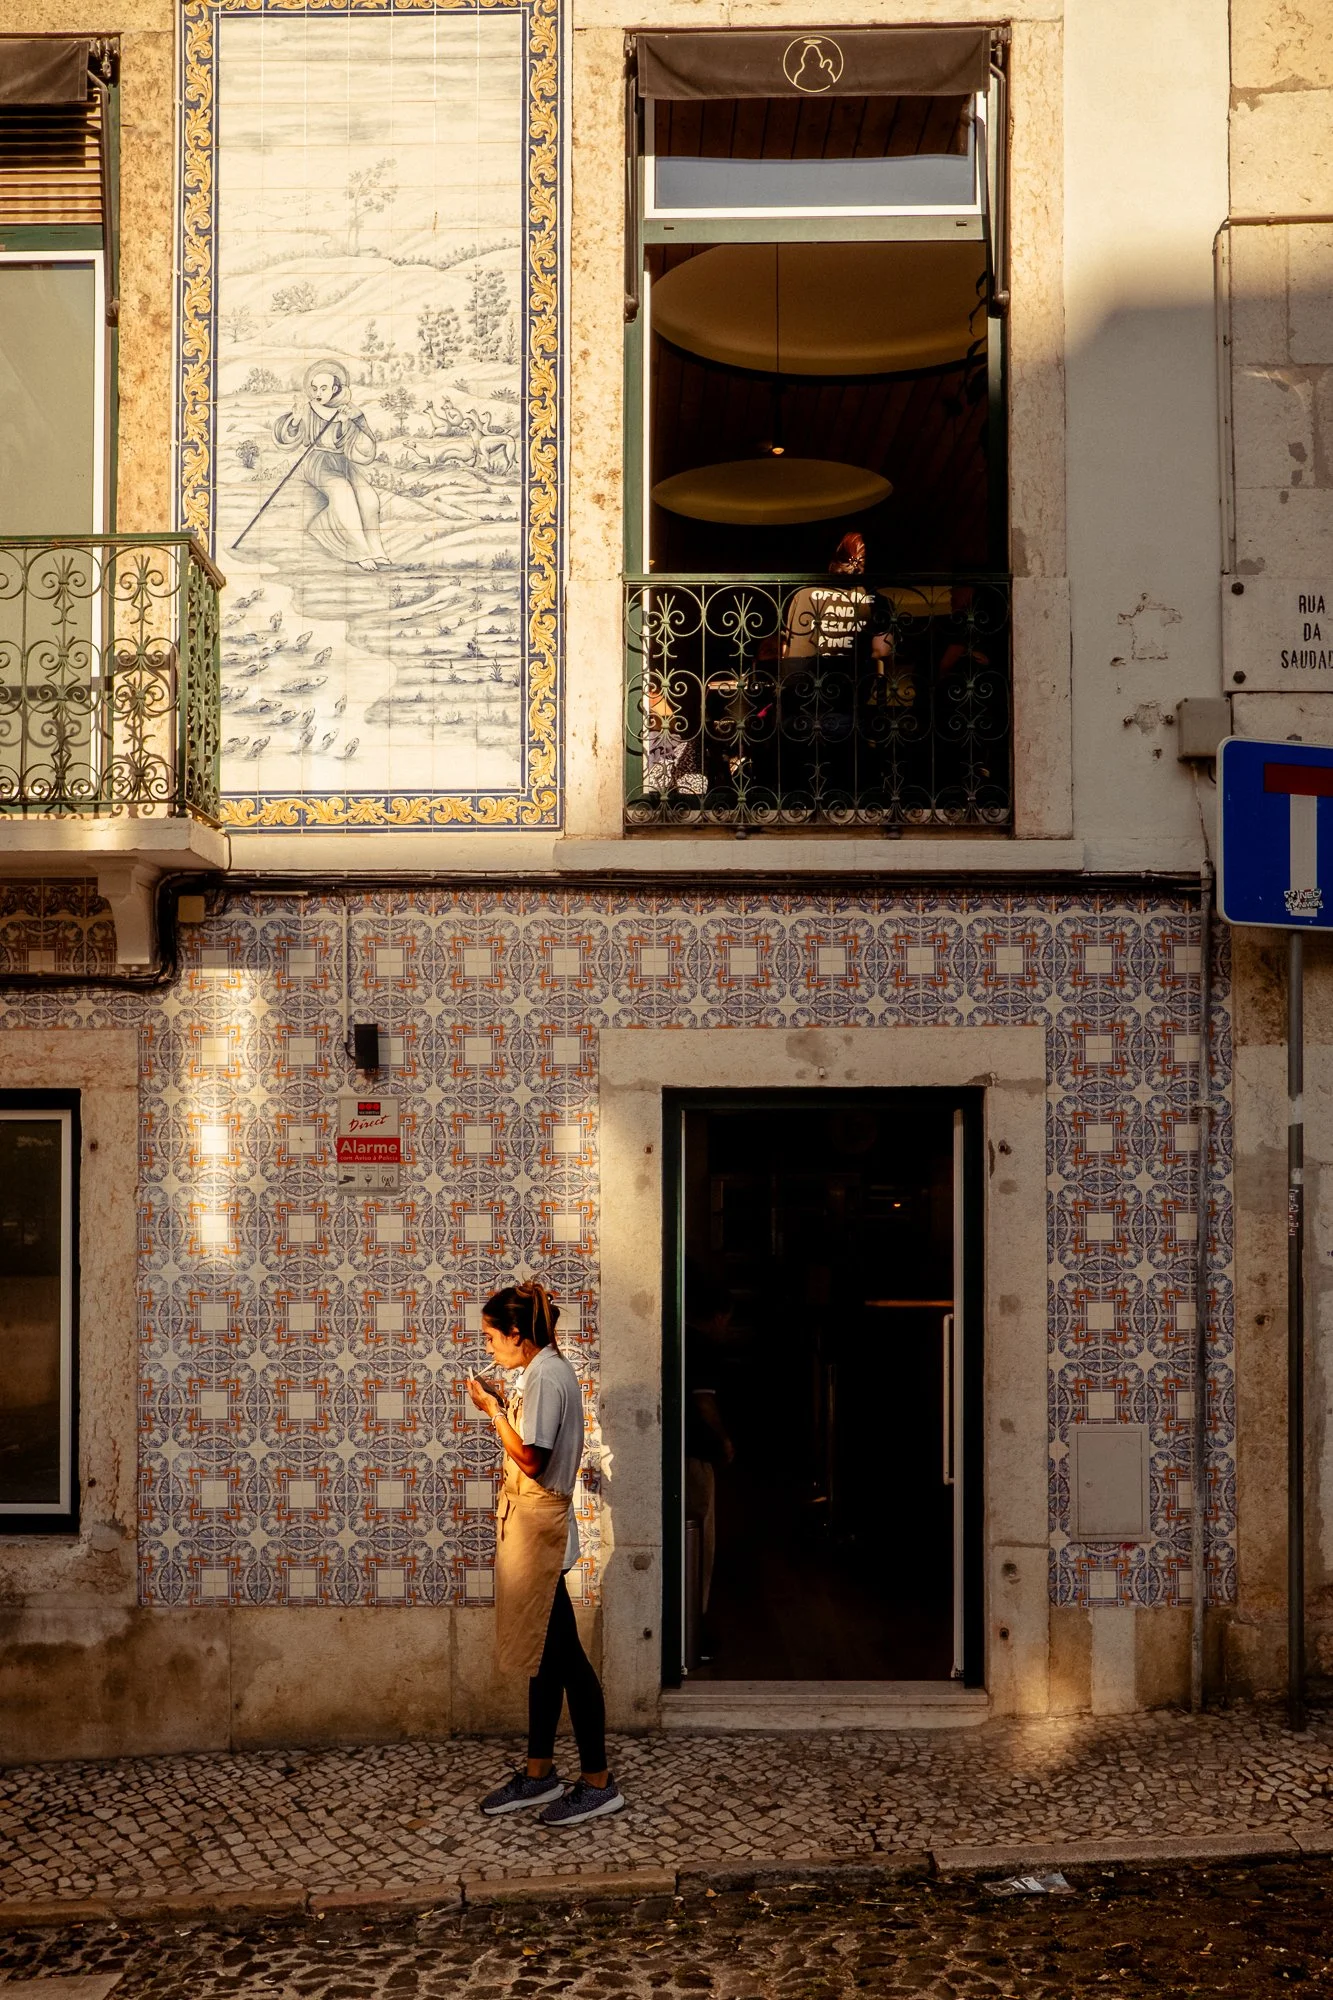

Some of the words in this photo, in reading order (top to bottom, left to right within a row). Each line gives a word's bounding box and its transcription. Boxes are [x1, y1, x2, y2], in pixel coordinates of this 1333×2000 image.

[811, 590, 875, 603] OFFLINE
[1299, 595, 1325, 614] RUA
[825, 605, 855, 618] AND
[1304, 623, 1321, 641] DA
[818, 636, 853, 648] FINE
[348, 1115, 391, 1132] Direct
[340, 1140, 398, 1153] Alarme
